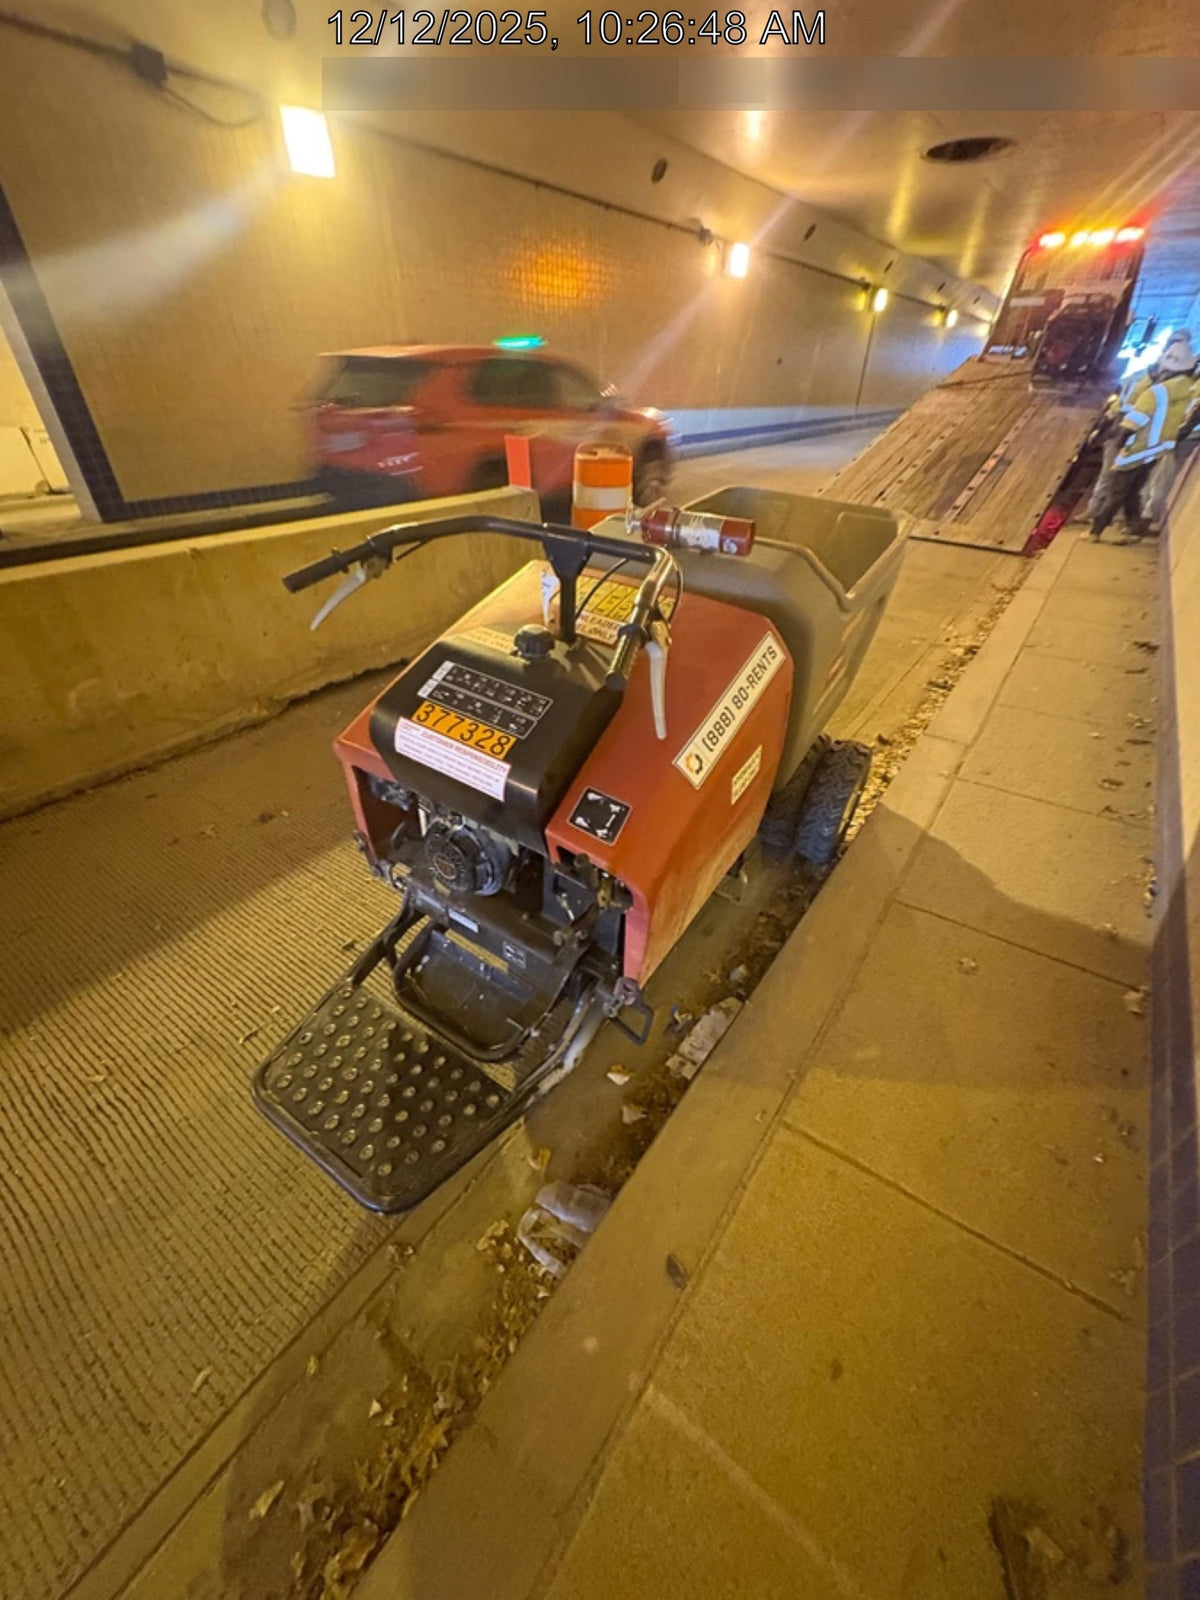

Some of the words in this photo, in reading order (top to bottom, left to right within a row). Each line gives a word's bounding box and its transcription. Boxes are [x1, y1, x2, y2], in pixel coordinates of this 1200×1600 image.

[416, 703, 511, 756] 377328
[701, 706, 736, 752] (888)
[731, 645, 778, 711] 80-RENTS
